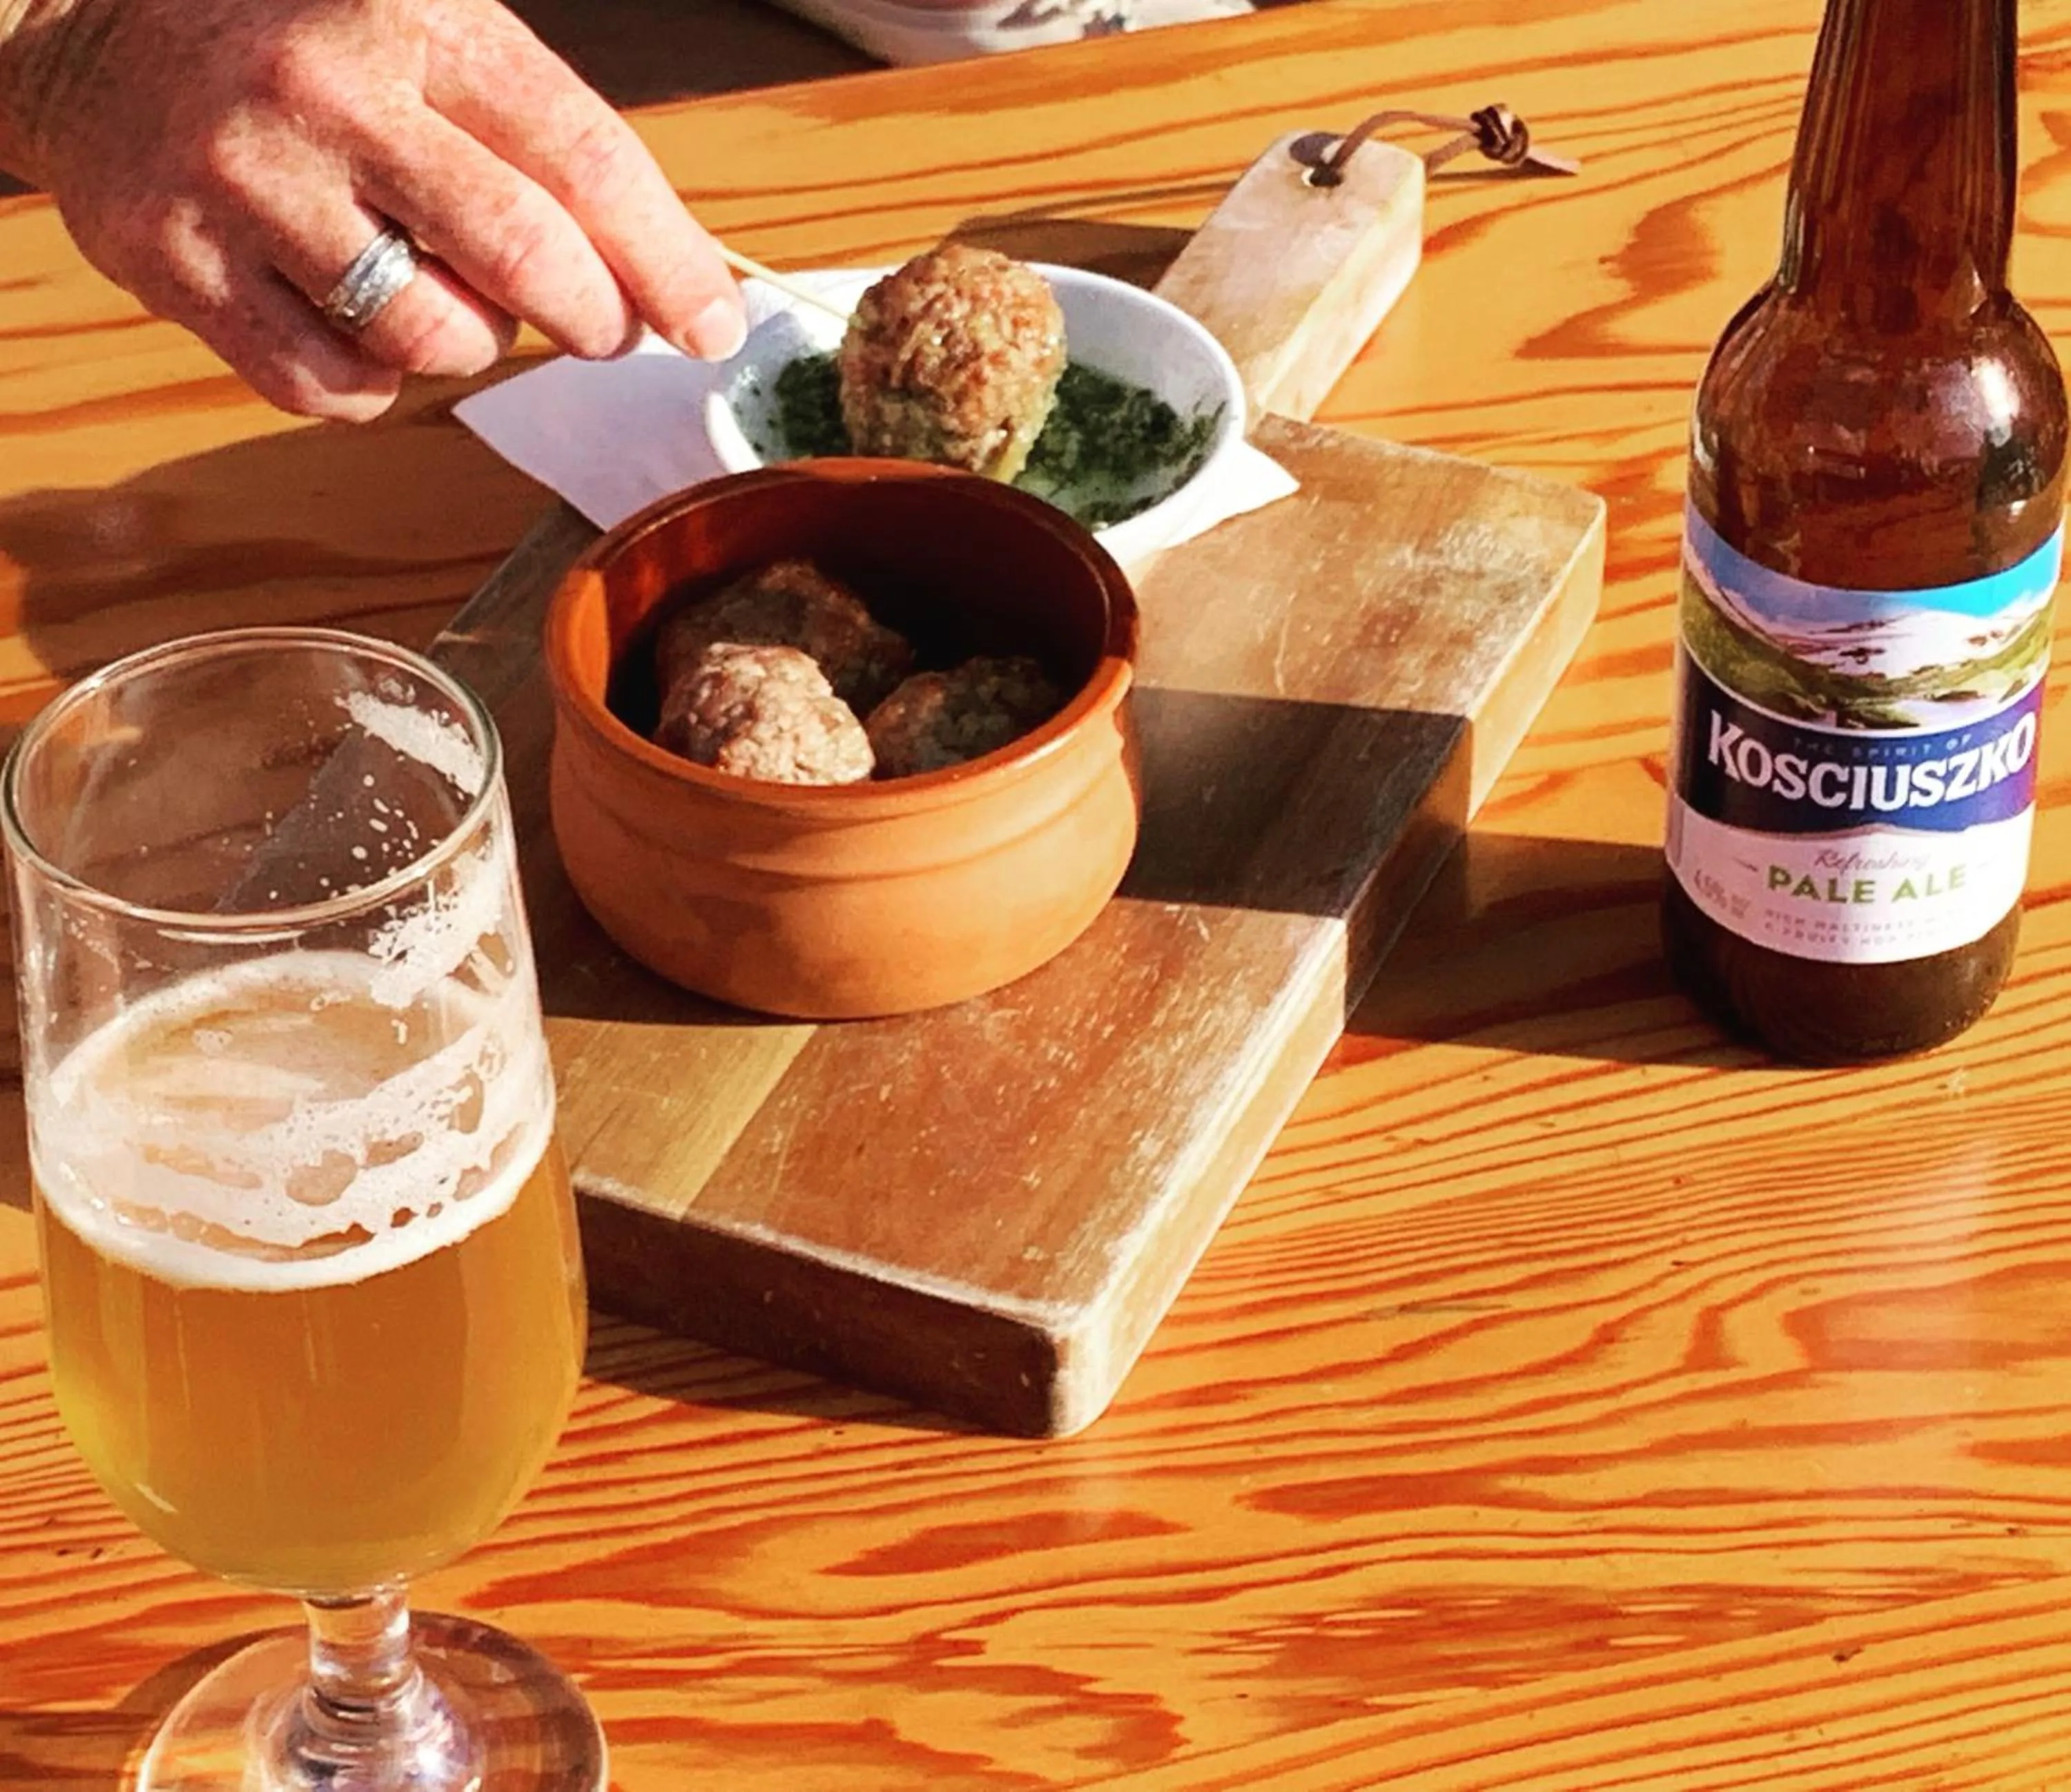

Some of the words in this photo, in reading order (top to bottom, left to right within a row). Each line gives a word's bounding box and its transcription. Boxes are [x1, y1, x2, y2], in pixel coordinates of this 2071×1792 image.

[1708, 709, 2036, 811] KOSCIUSZKO
[1946, 733, 1972, 751] OF
[1767, 864, 1876, 904] PALE
[1891, 863, 1967, 904] ALE
